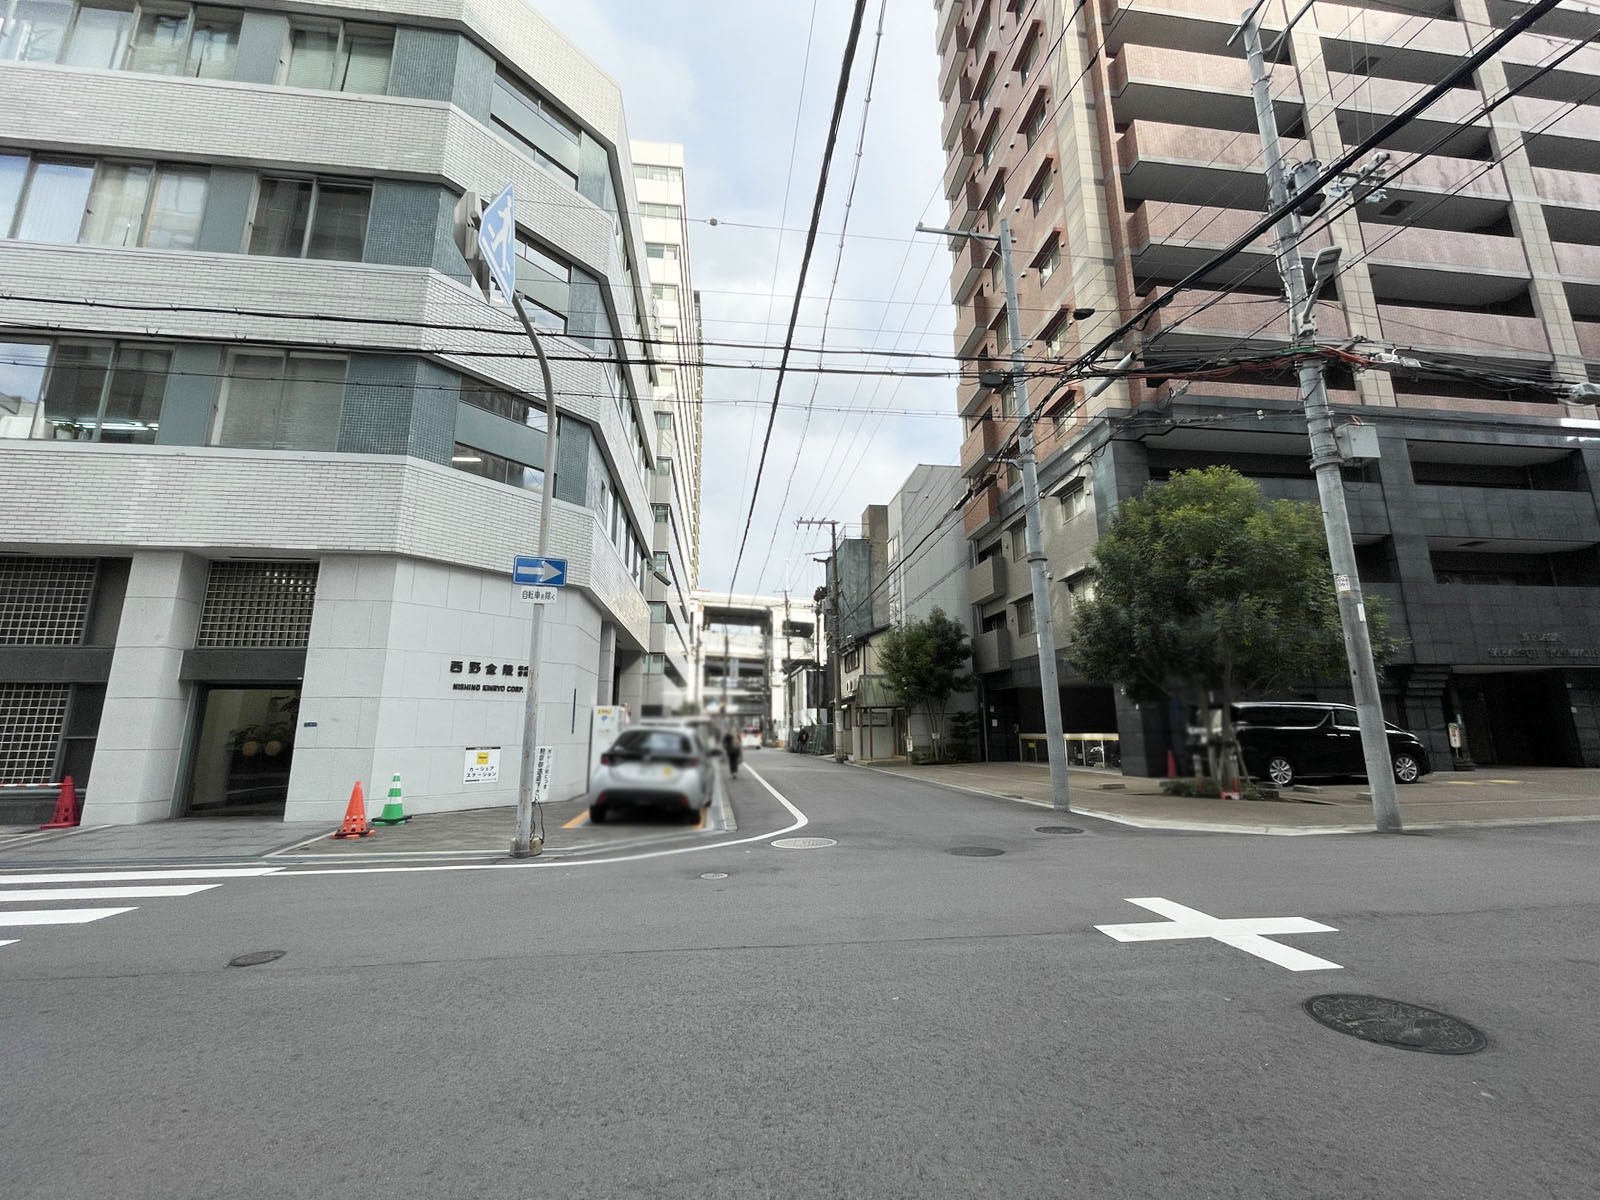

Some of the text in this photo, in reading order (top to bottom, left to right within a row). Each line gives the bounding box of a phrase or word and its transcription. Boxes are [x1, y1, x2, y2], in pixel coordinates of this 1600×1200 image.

[522, 590, 555, 600] 自転車を除く
[452, 683, 480, 691] NISHINO
